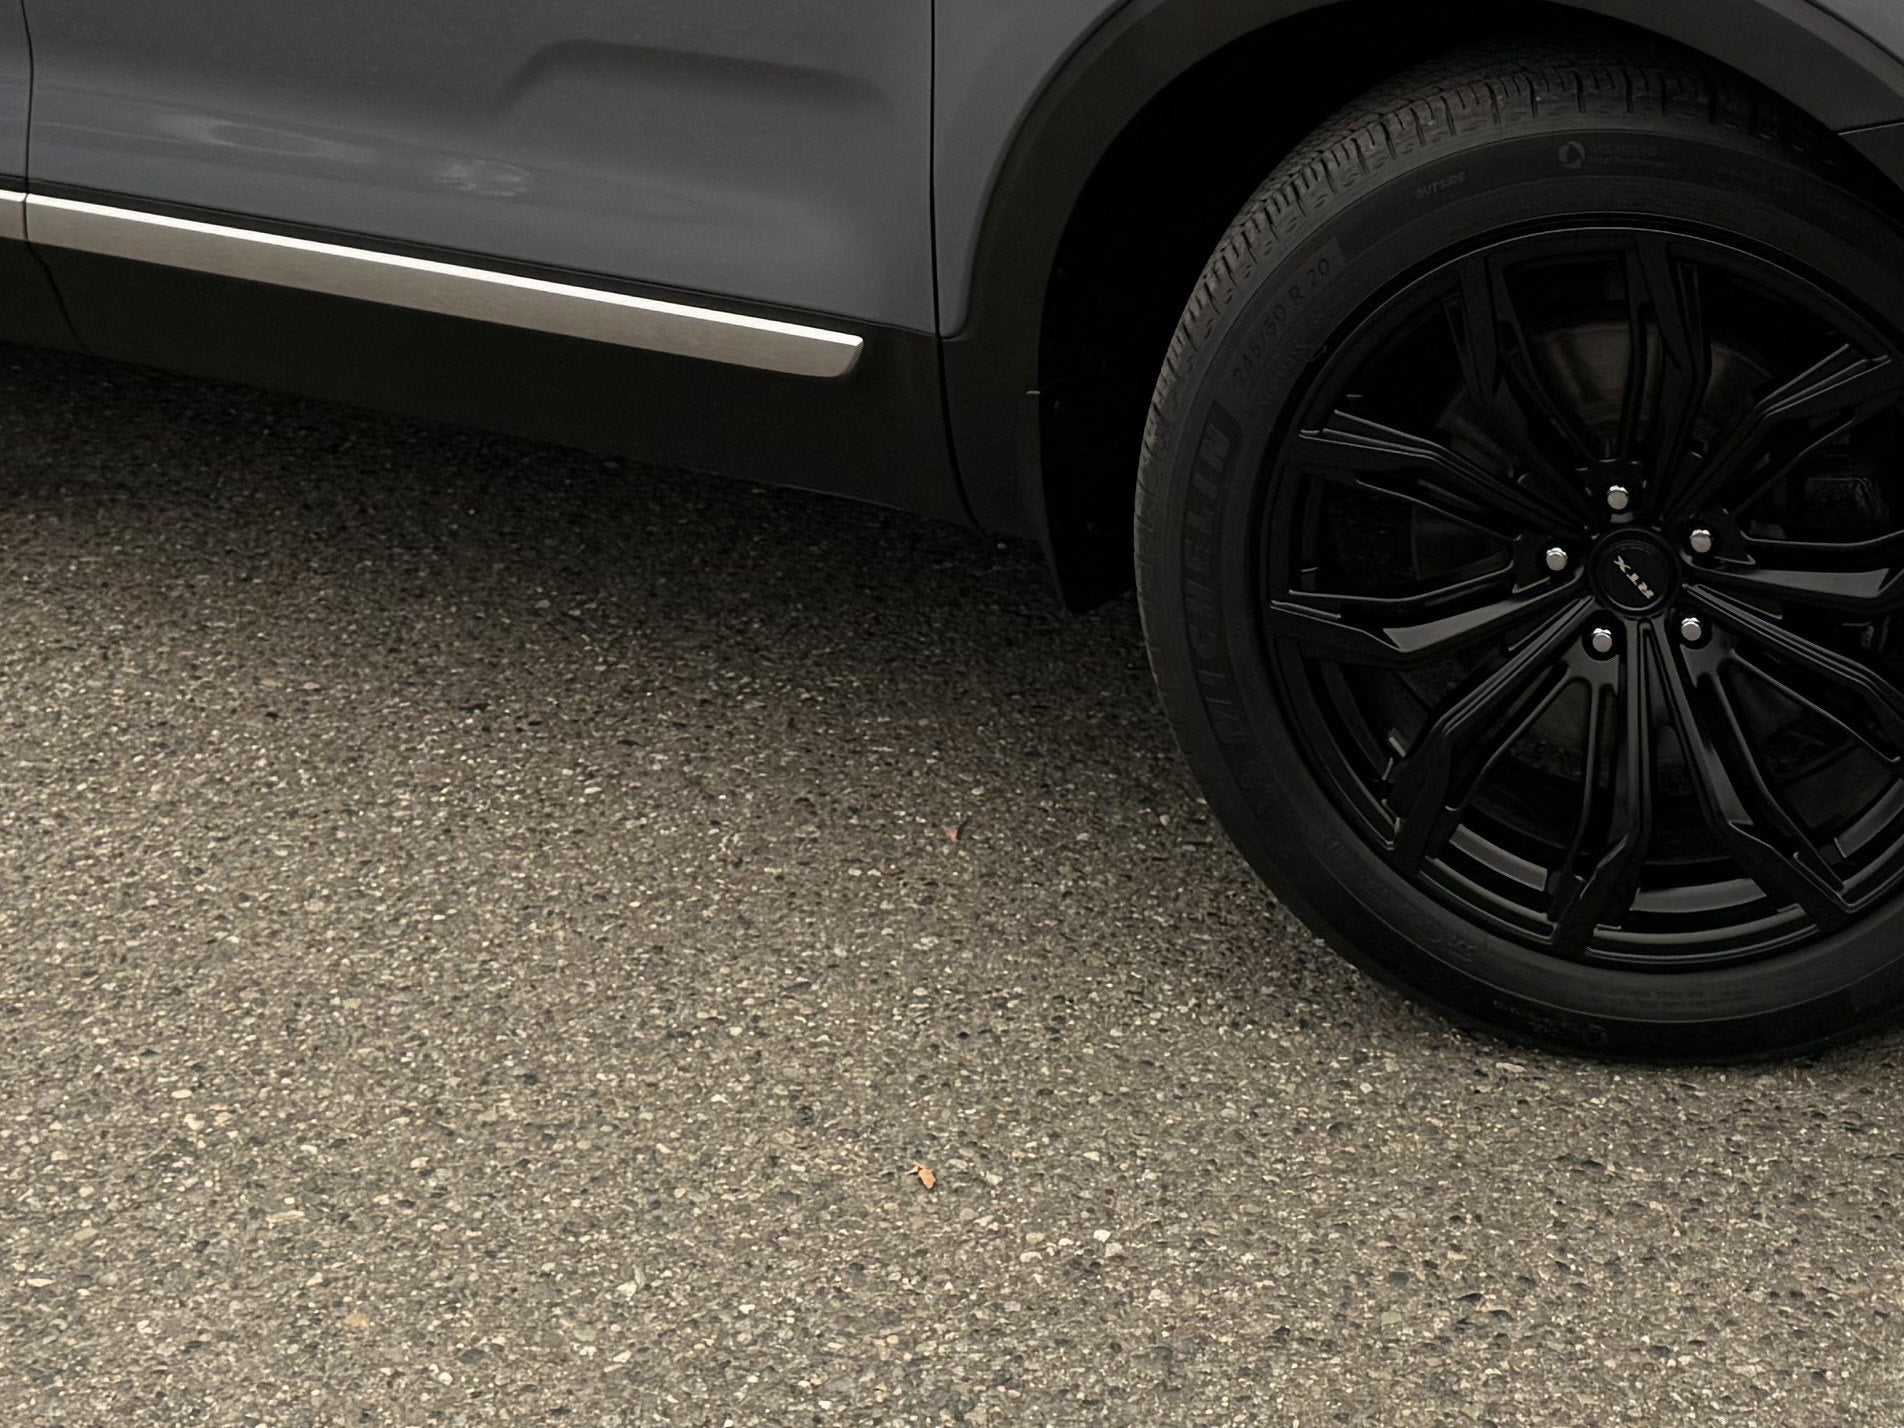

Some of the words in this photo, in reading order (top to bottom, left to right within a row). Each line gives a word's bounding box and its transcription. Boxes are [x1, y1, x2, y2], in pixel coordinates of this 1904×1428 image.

[1413, 171, 1466, 199] OUTSIDE
[1307, 257, 1330, 287] 20
[1184, 420, 1248, 744] MICHELIN
[1613, 554, 1655, 599] RTX
